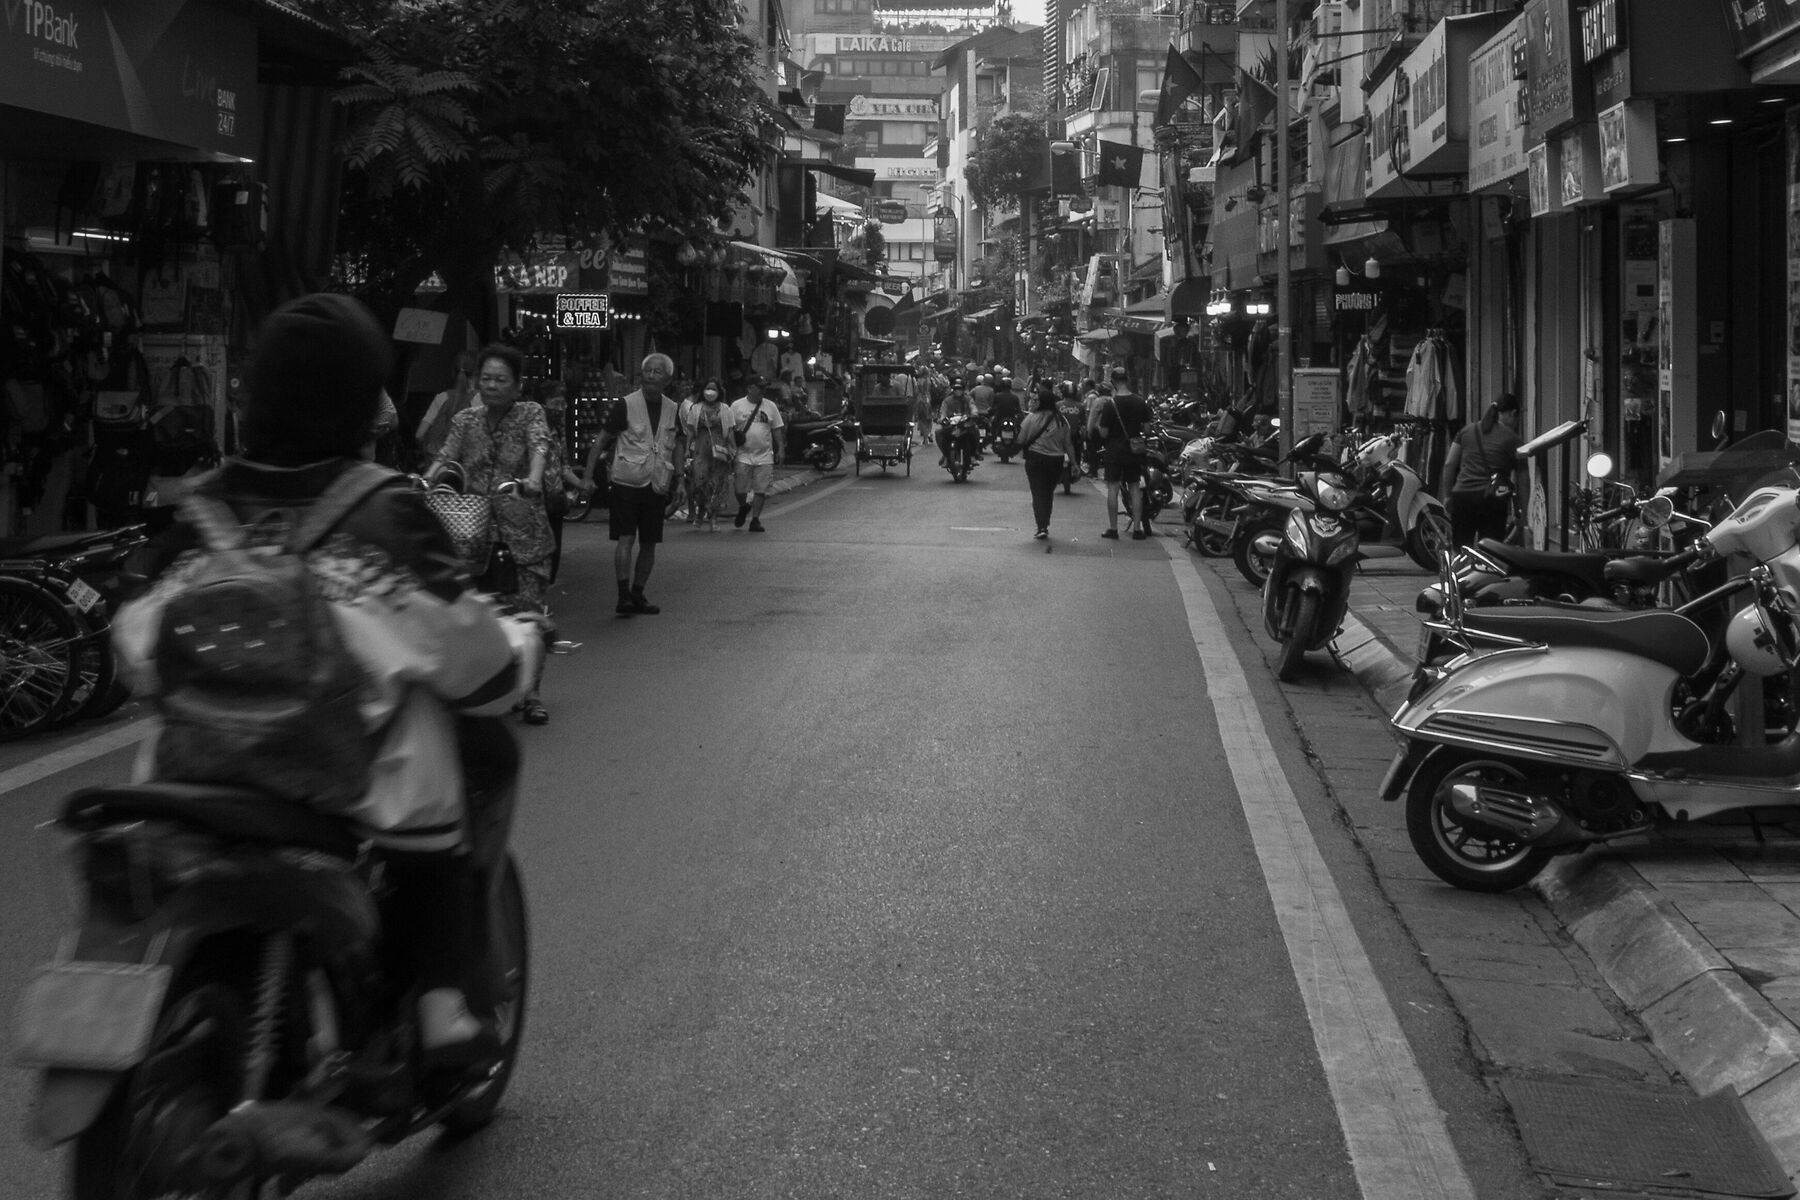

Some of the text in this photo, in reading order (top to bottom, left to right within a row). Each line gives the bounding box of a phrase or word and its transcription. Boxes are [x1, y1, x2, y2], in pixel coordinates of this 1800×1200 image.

[840, 37, 889, 52] LAIKA
[217, 88, 236, 110] BANK
[218, 113, 235, 135] 24/7
[559, 298, 606, 311] COFFEE
[1059, 405, 1080, 415] Grab
